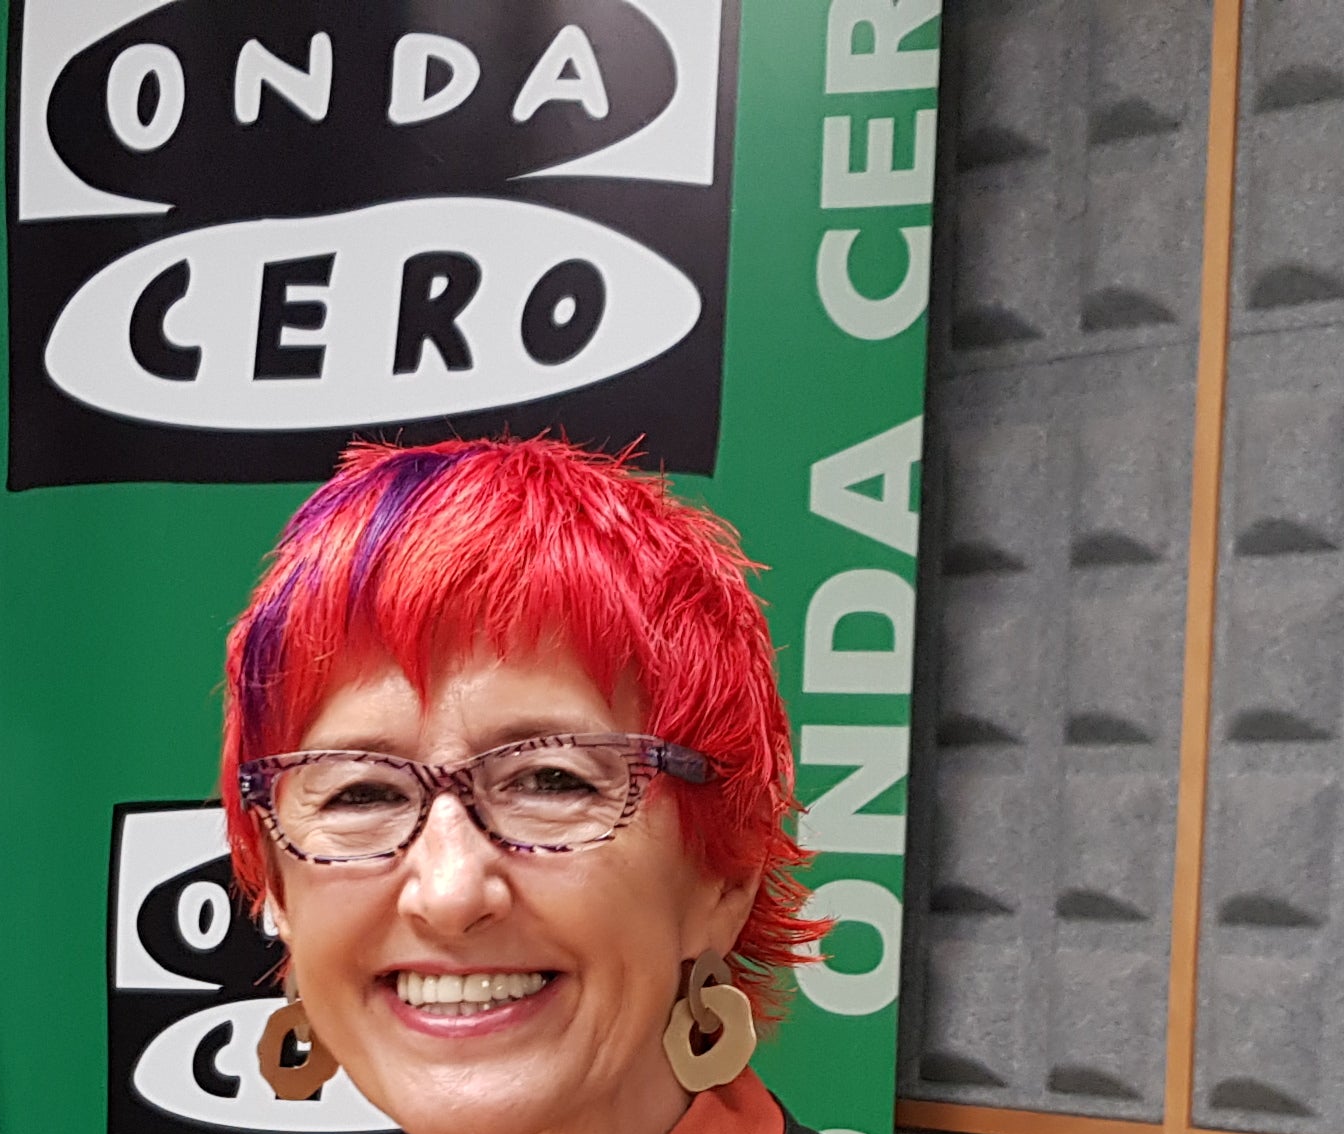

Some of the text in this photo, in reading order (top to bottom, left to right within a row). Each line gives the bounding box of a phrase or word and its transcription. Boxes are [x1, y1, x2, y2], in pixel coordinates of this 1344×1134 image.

[106, 24, 610, 151] ONDA
[128, 250, 606, 382] CERO
[793, 415, 924, 1016] ONDA
